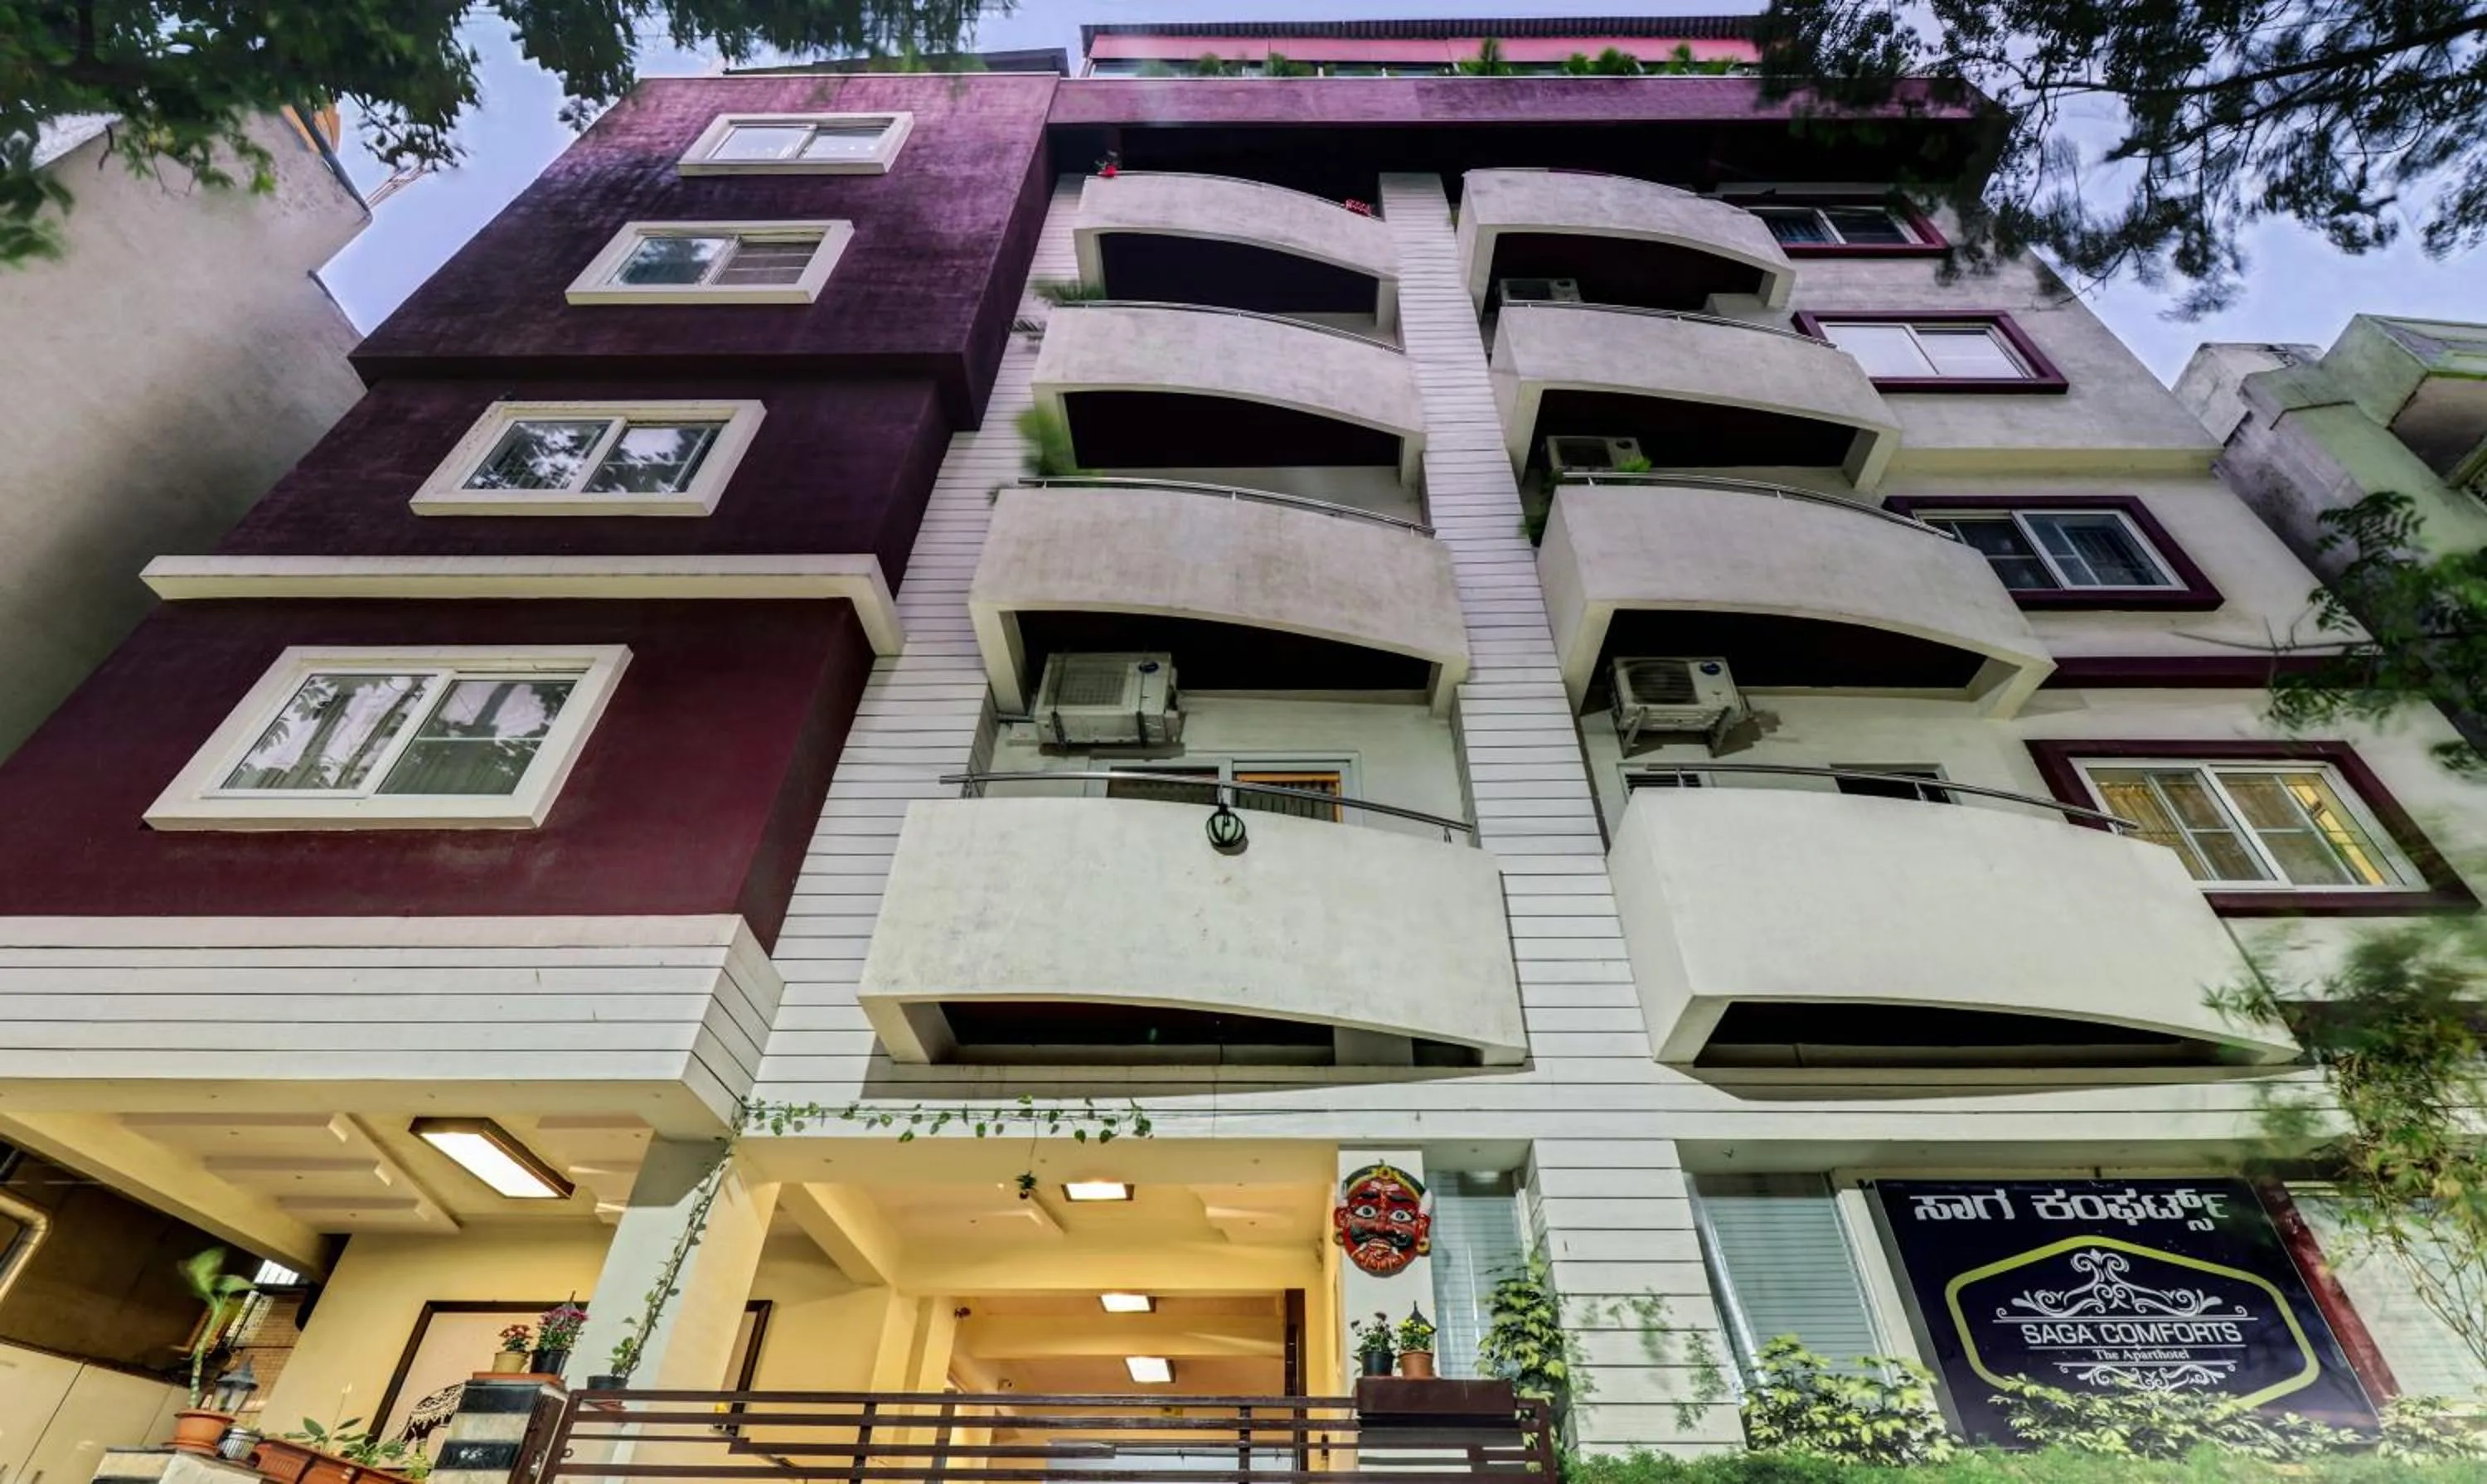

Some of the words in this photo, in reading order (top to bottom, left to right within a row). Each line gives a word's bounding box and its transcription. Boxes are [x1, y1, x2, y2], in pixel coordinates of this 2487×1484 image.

[2021, 1324, 2097, 1345] SAGA
[2100, 1322, 2242, 1343] COMFORTS
[2092, 1349, 2119, 1360] The
[2123, 1349, 2190, 1362] Aparthotel
